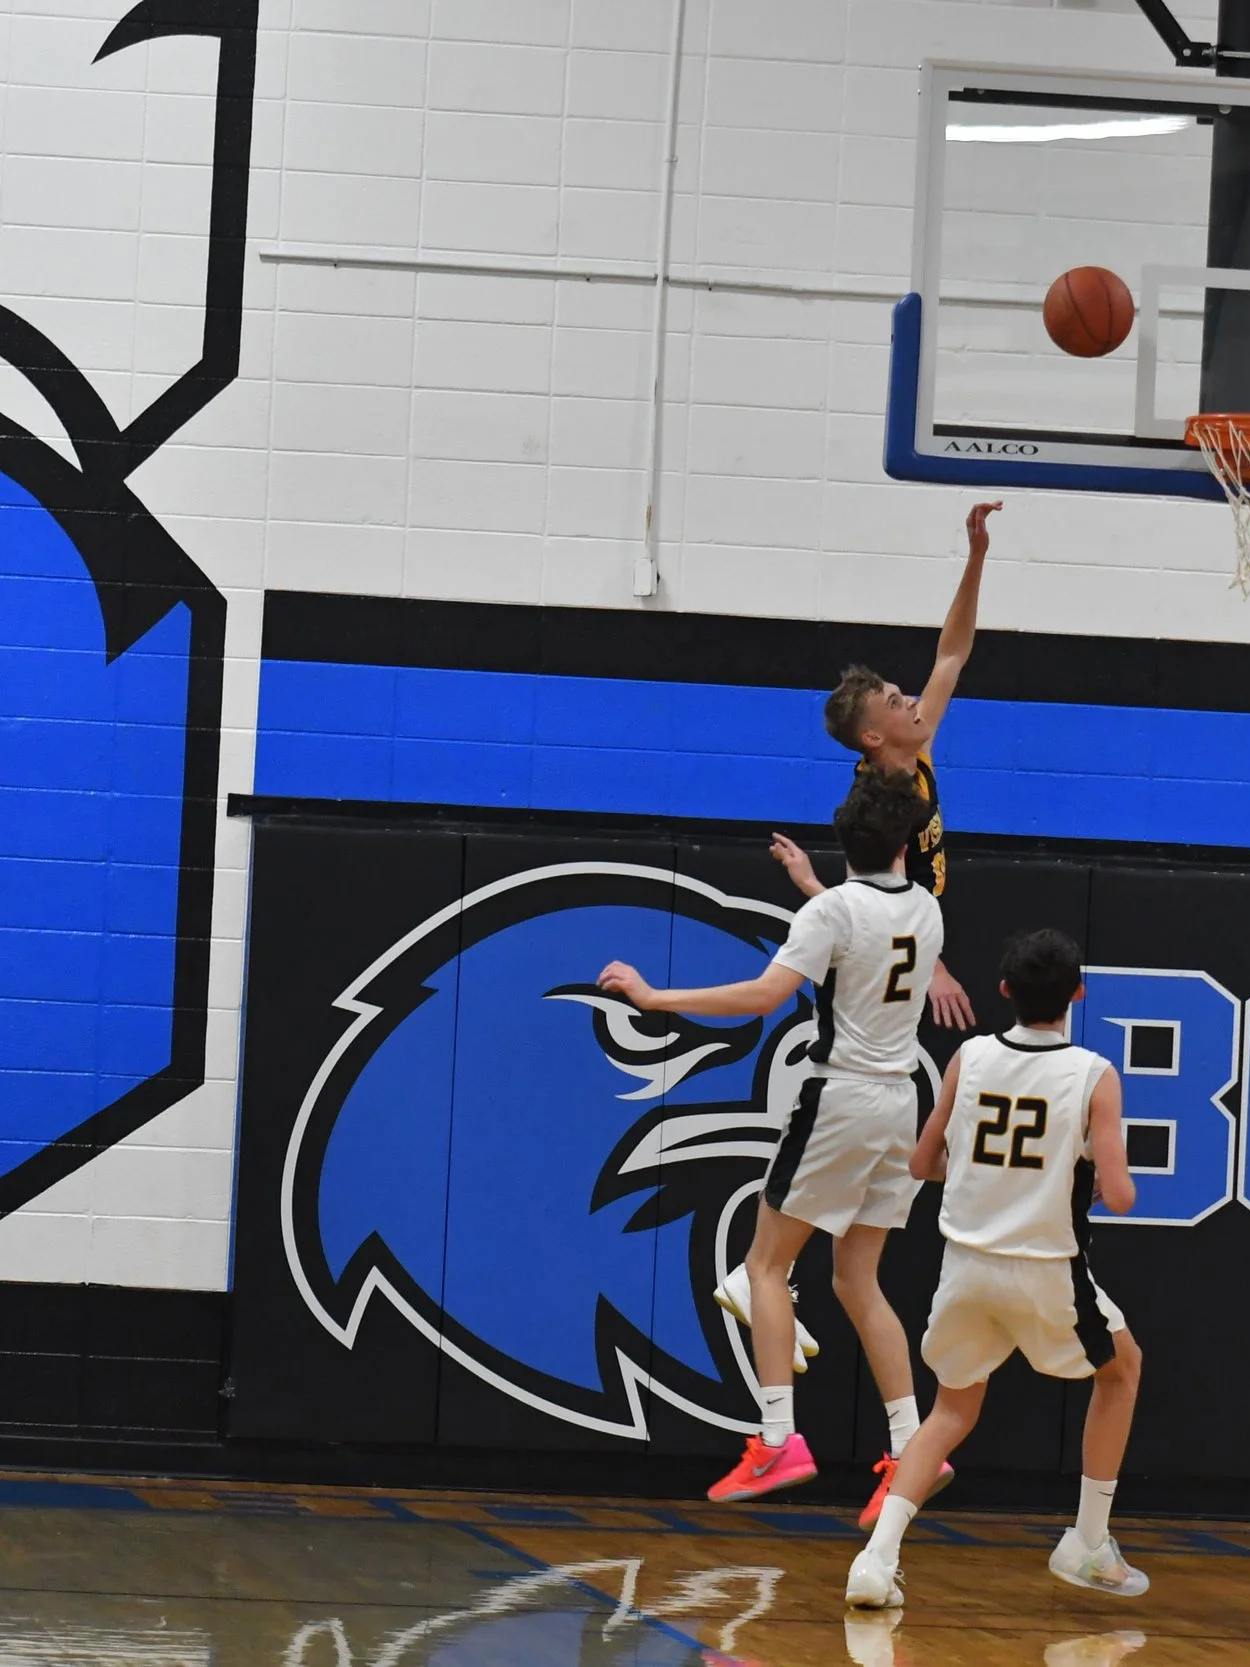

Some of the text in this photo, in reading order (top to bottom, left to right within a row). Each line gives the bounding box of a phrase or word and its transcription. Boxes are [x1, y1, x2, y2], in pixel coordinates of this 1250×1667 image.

[943, 440, 1040, 456] AALCO
[882, 934, 918, 1004] 2
[971, 1091, 1049, 1170] 22
